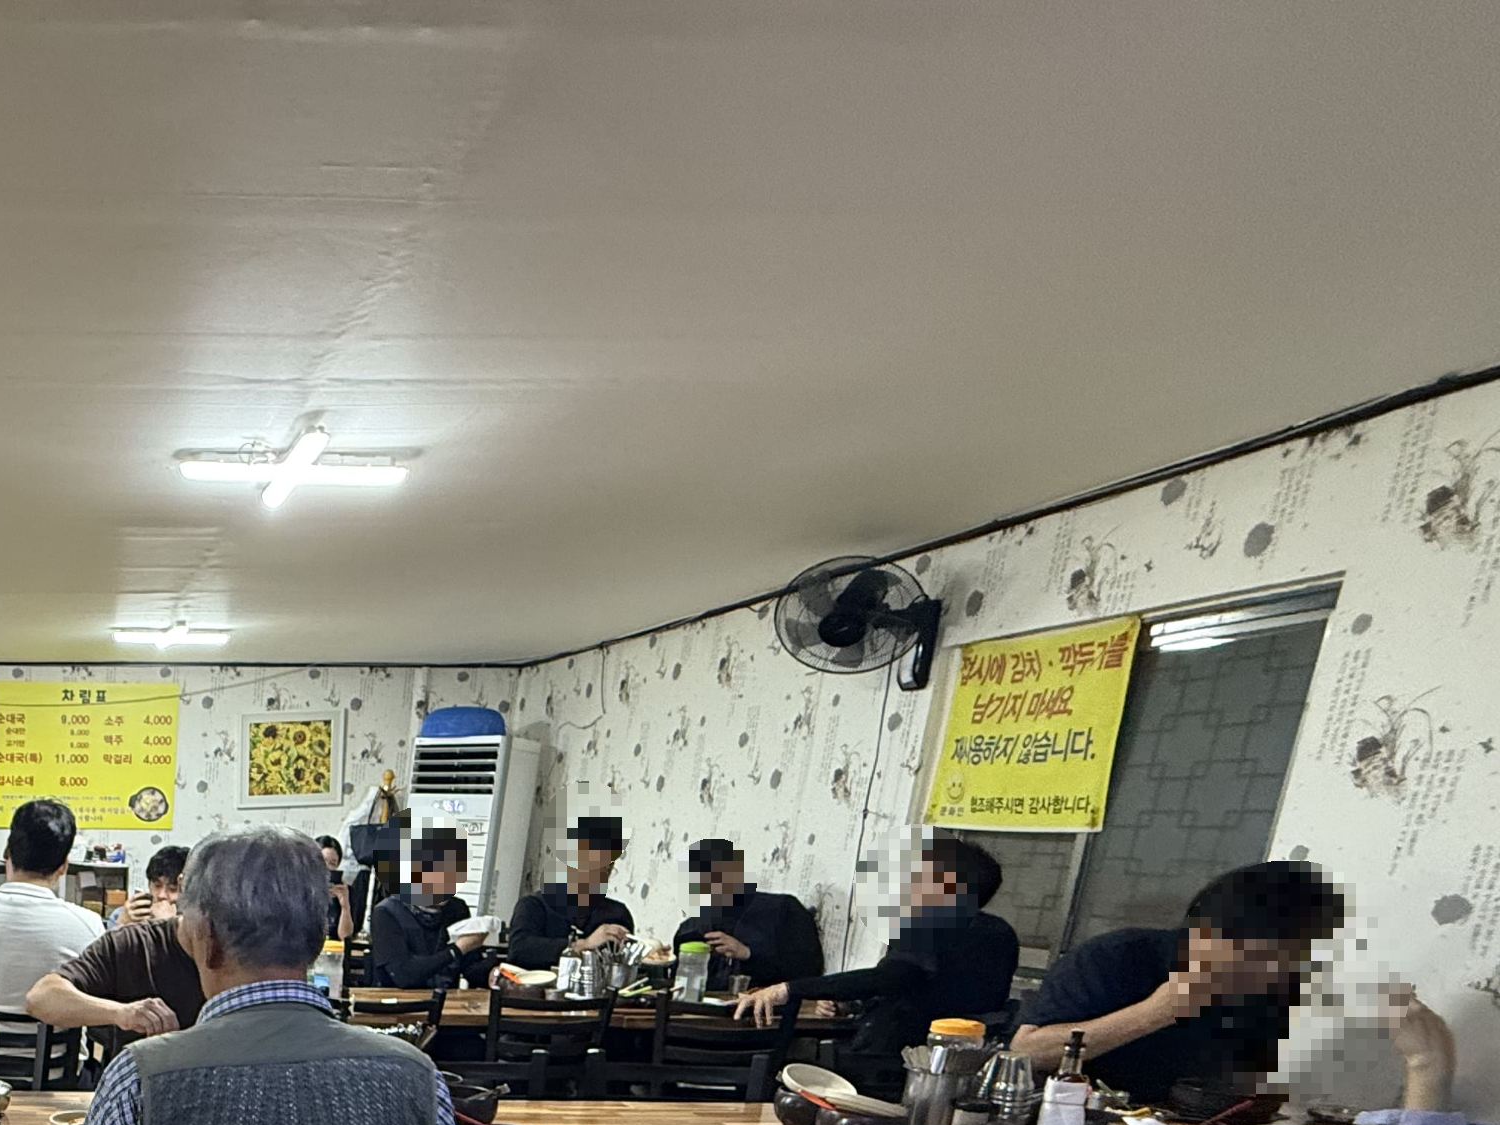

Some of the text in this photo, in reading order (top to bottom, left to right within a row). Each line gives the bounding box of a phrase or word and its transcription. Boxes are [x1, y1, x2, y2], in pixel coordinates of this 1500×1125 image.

[960, 653, 1006, 687] 접시에
[1011, 650, 1042, 684] 김치
[1059, 631, 1129, 677] 깍두기를
[971, 690, 1026, 724] 남기지
[104, 715, 173, 726] 소주 4,000
[104, 735, 172, 746] 맥주 4,000
[54, 754, 89, 764] 11,000
[103, 754, 172, 765] 막걸리 4,000
[59, 777, 88, 787] 8,000
[1028, 795, 1096, 815] 감사합니다.
